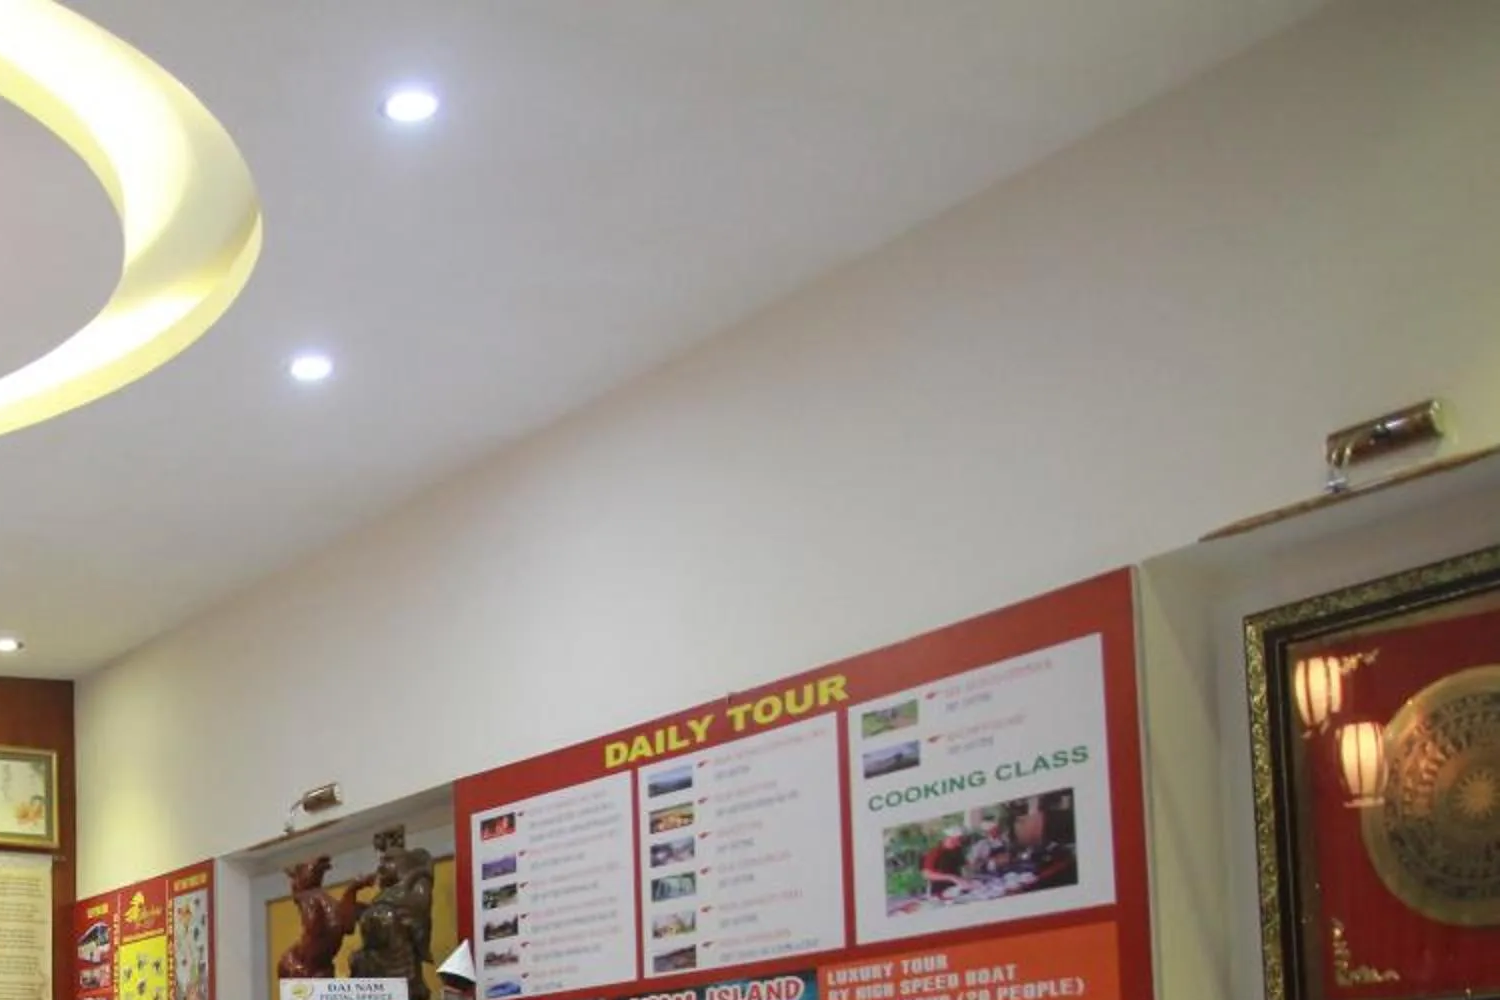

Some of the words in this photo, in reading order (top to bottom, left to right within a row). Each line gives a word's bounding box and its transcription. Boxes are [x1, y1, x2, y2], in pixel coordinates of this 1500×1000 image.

[604, 714, 714, 769] DAILY
[726, 674, 849, 732] TOUR
[868, 770, 987, 812] COOKING
[994, 745, 1090, 782] CLASS
[827, 962, 893, 986] LUXURY
[901, 954, 948, 975] TOUR
[856, 982, 894, 1000] HIGH
[900, 972, 959, 995] SPEED
[965, 964, 1017, 986] BOAT
